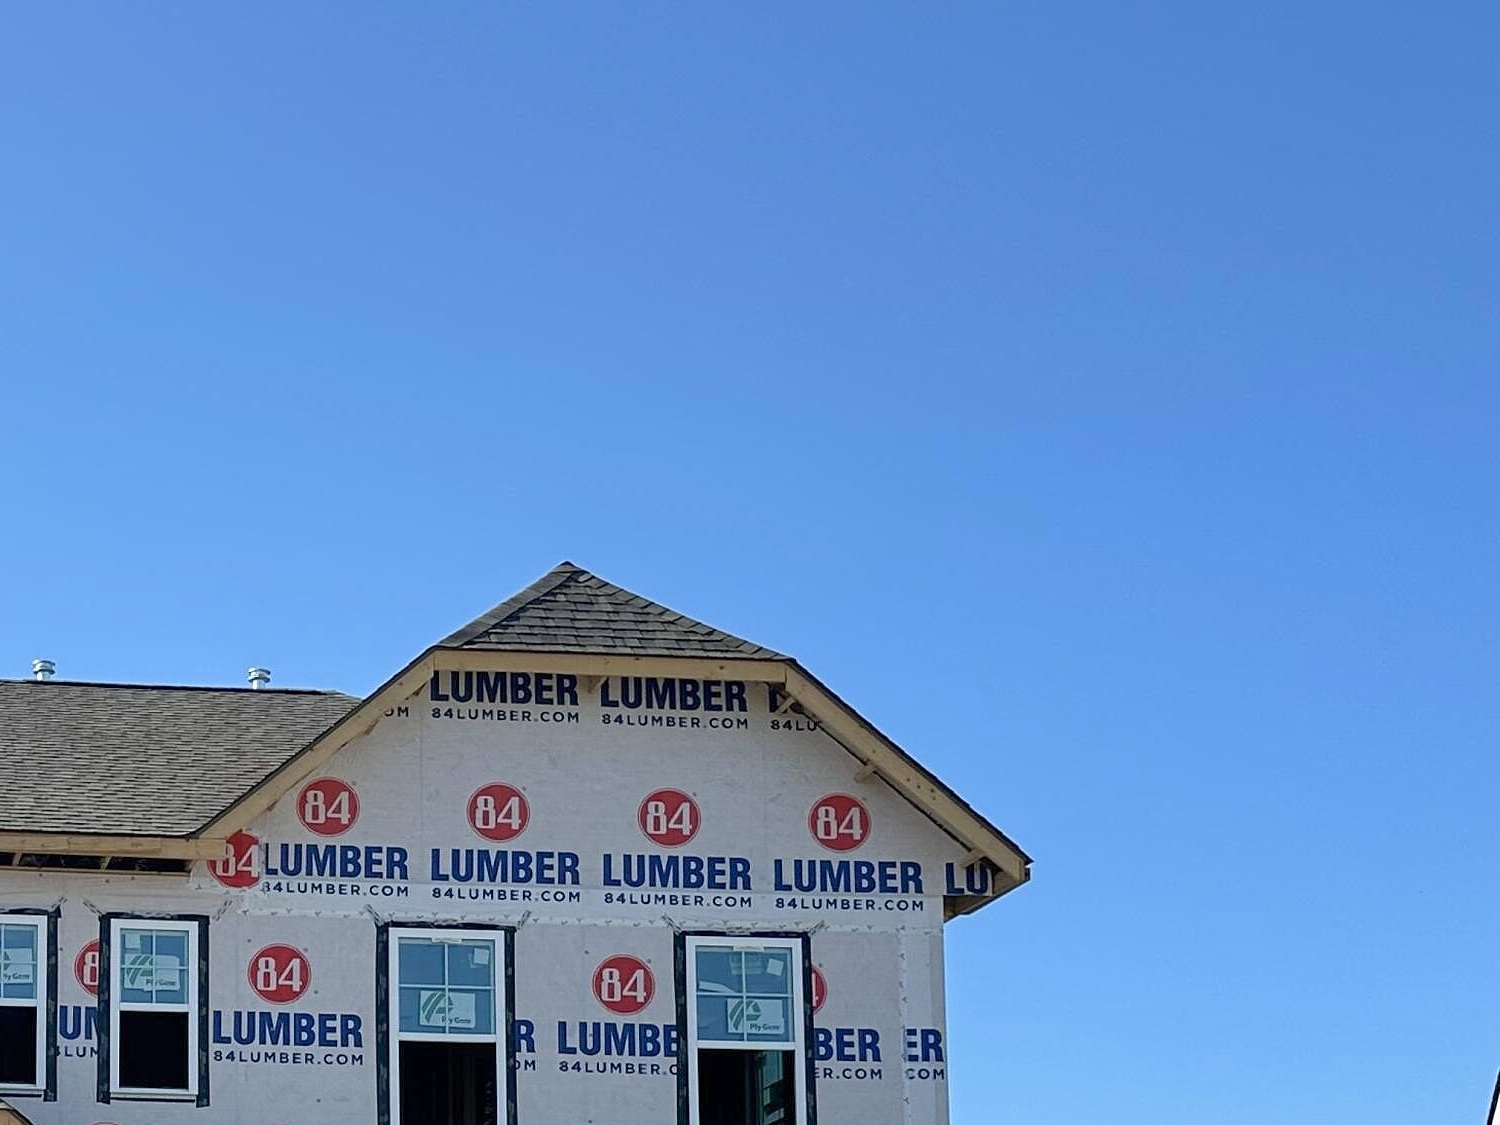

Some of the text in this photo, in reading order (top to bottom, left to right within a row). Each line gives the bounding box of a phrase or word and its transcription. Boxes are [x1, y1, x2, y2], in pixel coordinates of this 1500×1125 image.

[430, 671, 579, 706] LUMBER
[600, 676, 747, 713] LUMBER
[431, 707, 579, 724] 84LUMBER.COM
[601, 713, 748, 730] 84LUMBER.COM
[304, 790, 351, 825] 84
[475, 795, 521, 830] 84
[646, 801, 692, 836] 84
[817, 806, 862, 840] 84
[264, 842, 409, 880] LUMBER
[431, 848, 580, 885] LUMBER
[603, 853, 752, 890] LUMBER
[774, 858, 923, 894] LUMBER
[431, 887, 580, 903] 84LUMBER.COM
[604, 892, 752, 908] 84LUMBER.COM
[775, 897, 924, 912] 84LUMBER.COM
[257, 956, 302, 992] 84
[601, 967, 647, 1002] 84
[212, 1010, 363, 1048] LUMBER
[213, 1051, 364, 1065] 84LUMBER.COM
